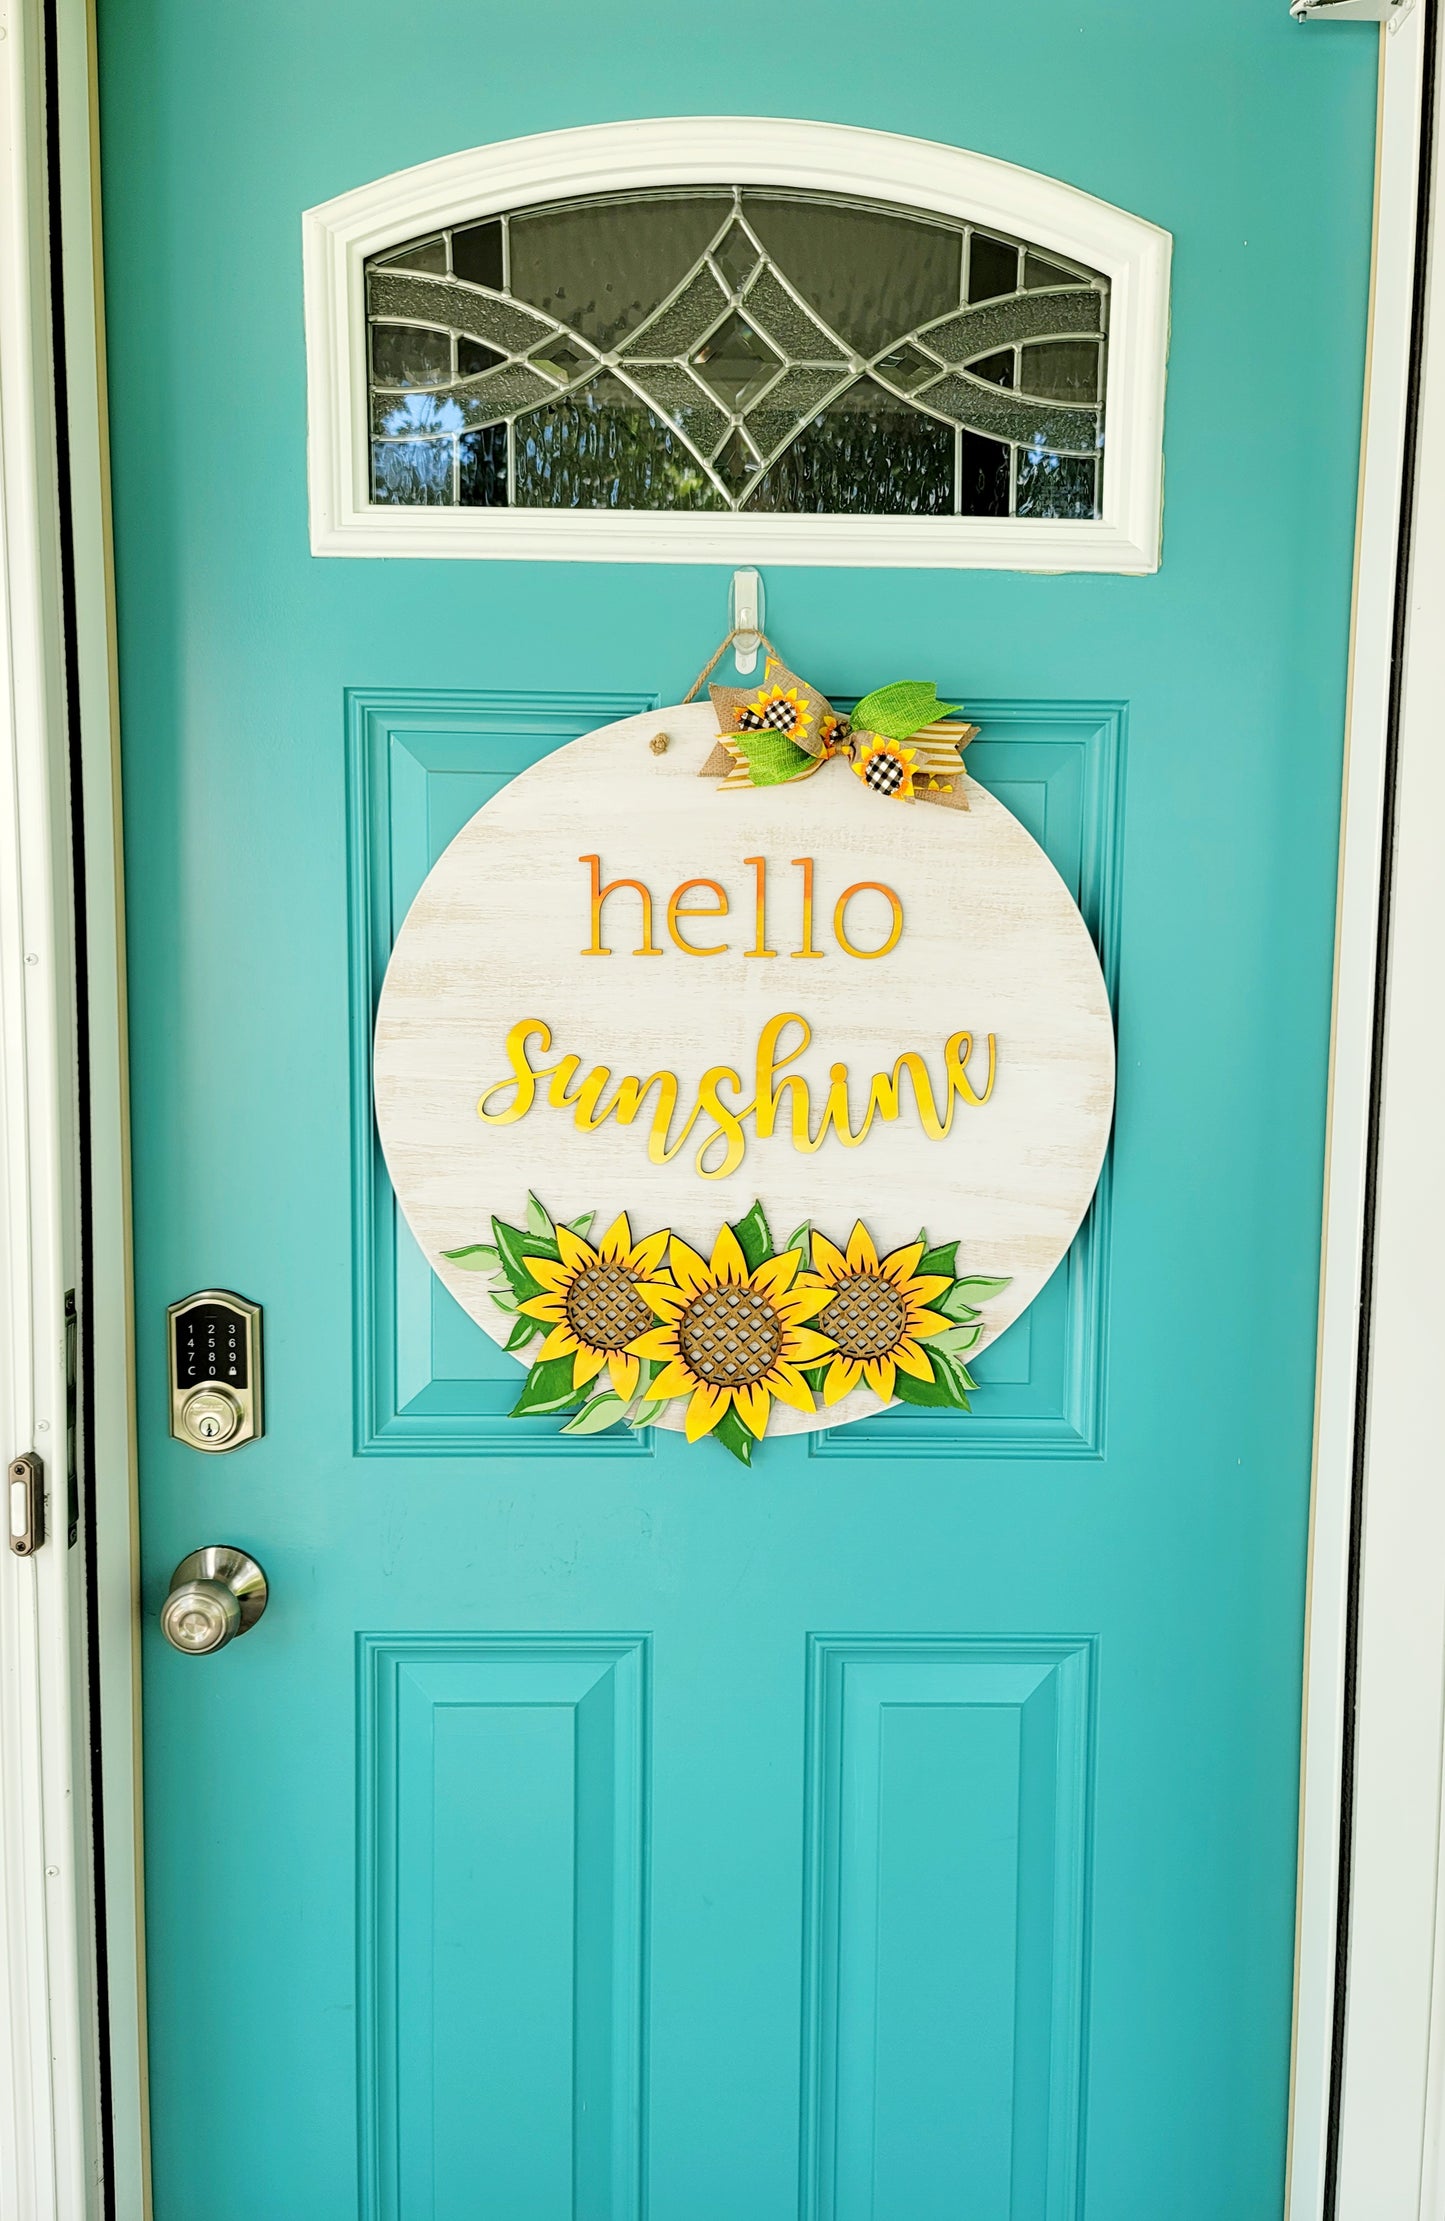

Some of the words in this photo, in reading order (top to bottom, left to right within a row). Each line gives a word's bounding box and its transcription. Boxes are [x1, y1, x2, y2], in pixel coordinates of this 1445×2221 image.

[578, 853, 904, 960] hello
[188, 1324, 193, 1334] 1
[208, 1324, 215, 1334] 2
[228, 1324, 235, 1334] 3
[187, 1338, 195, 1348] 4
[208, 1338, 215, 1348] 5
[228, 1338, 236, 1348] 6
[188, 1352, 195, 1362] 7
[208, 1352, 216, 1362] 8
[229, 1352, 236, 1362] 9
[187, 1366, 196, 1376] C
[208, 1366, 216, 1376] 0
